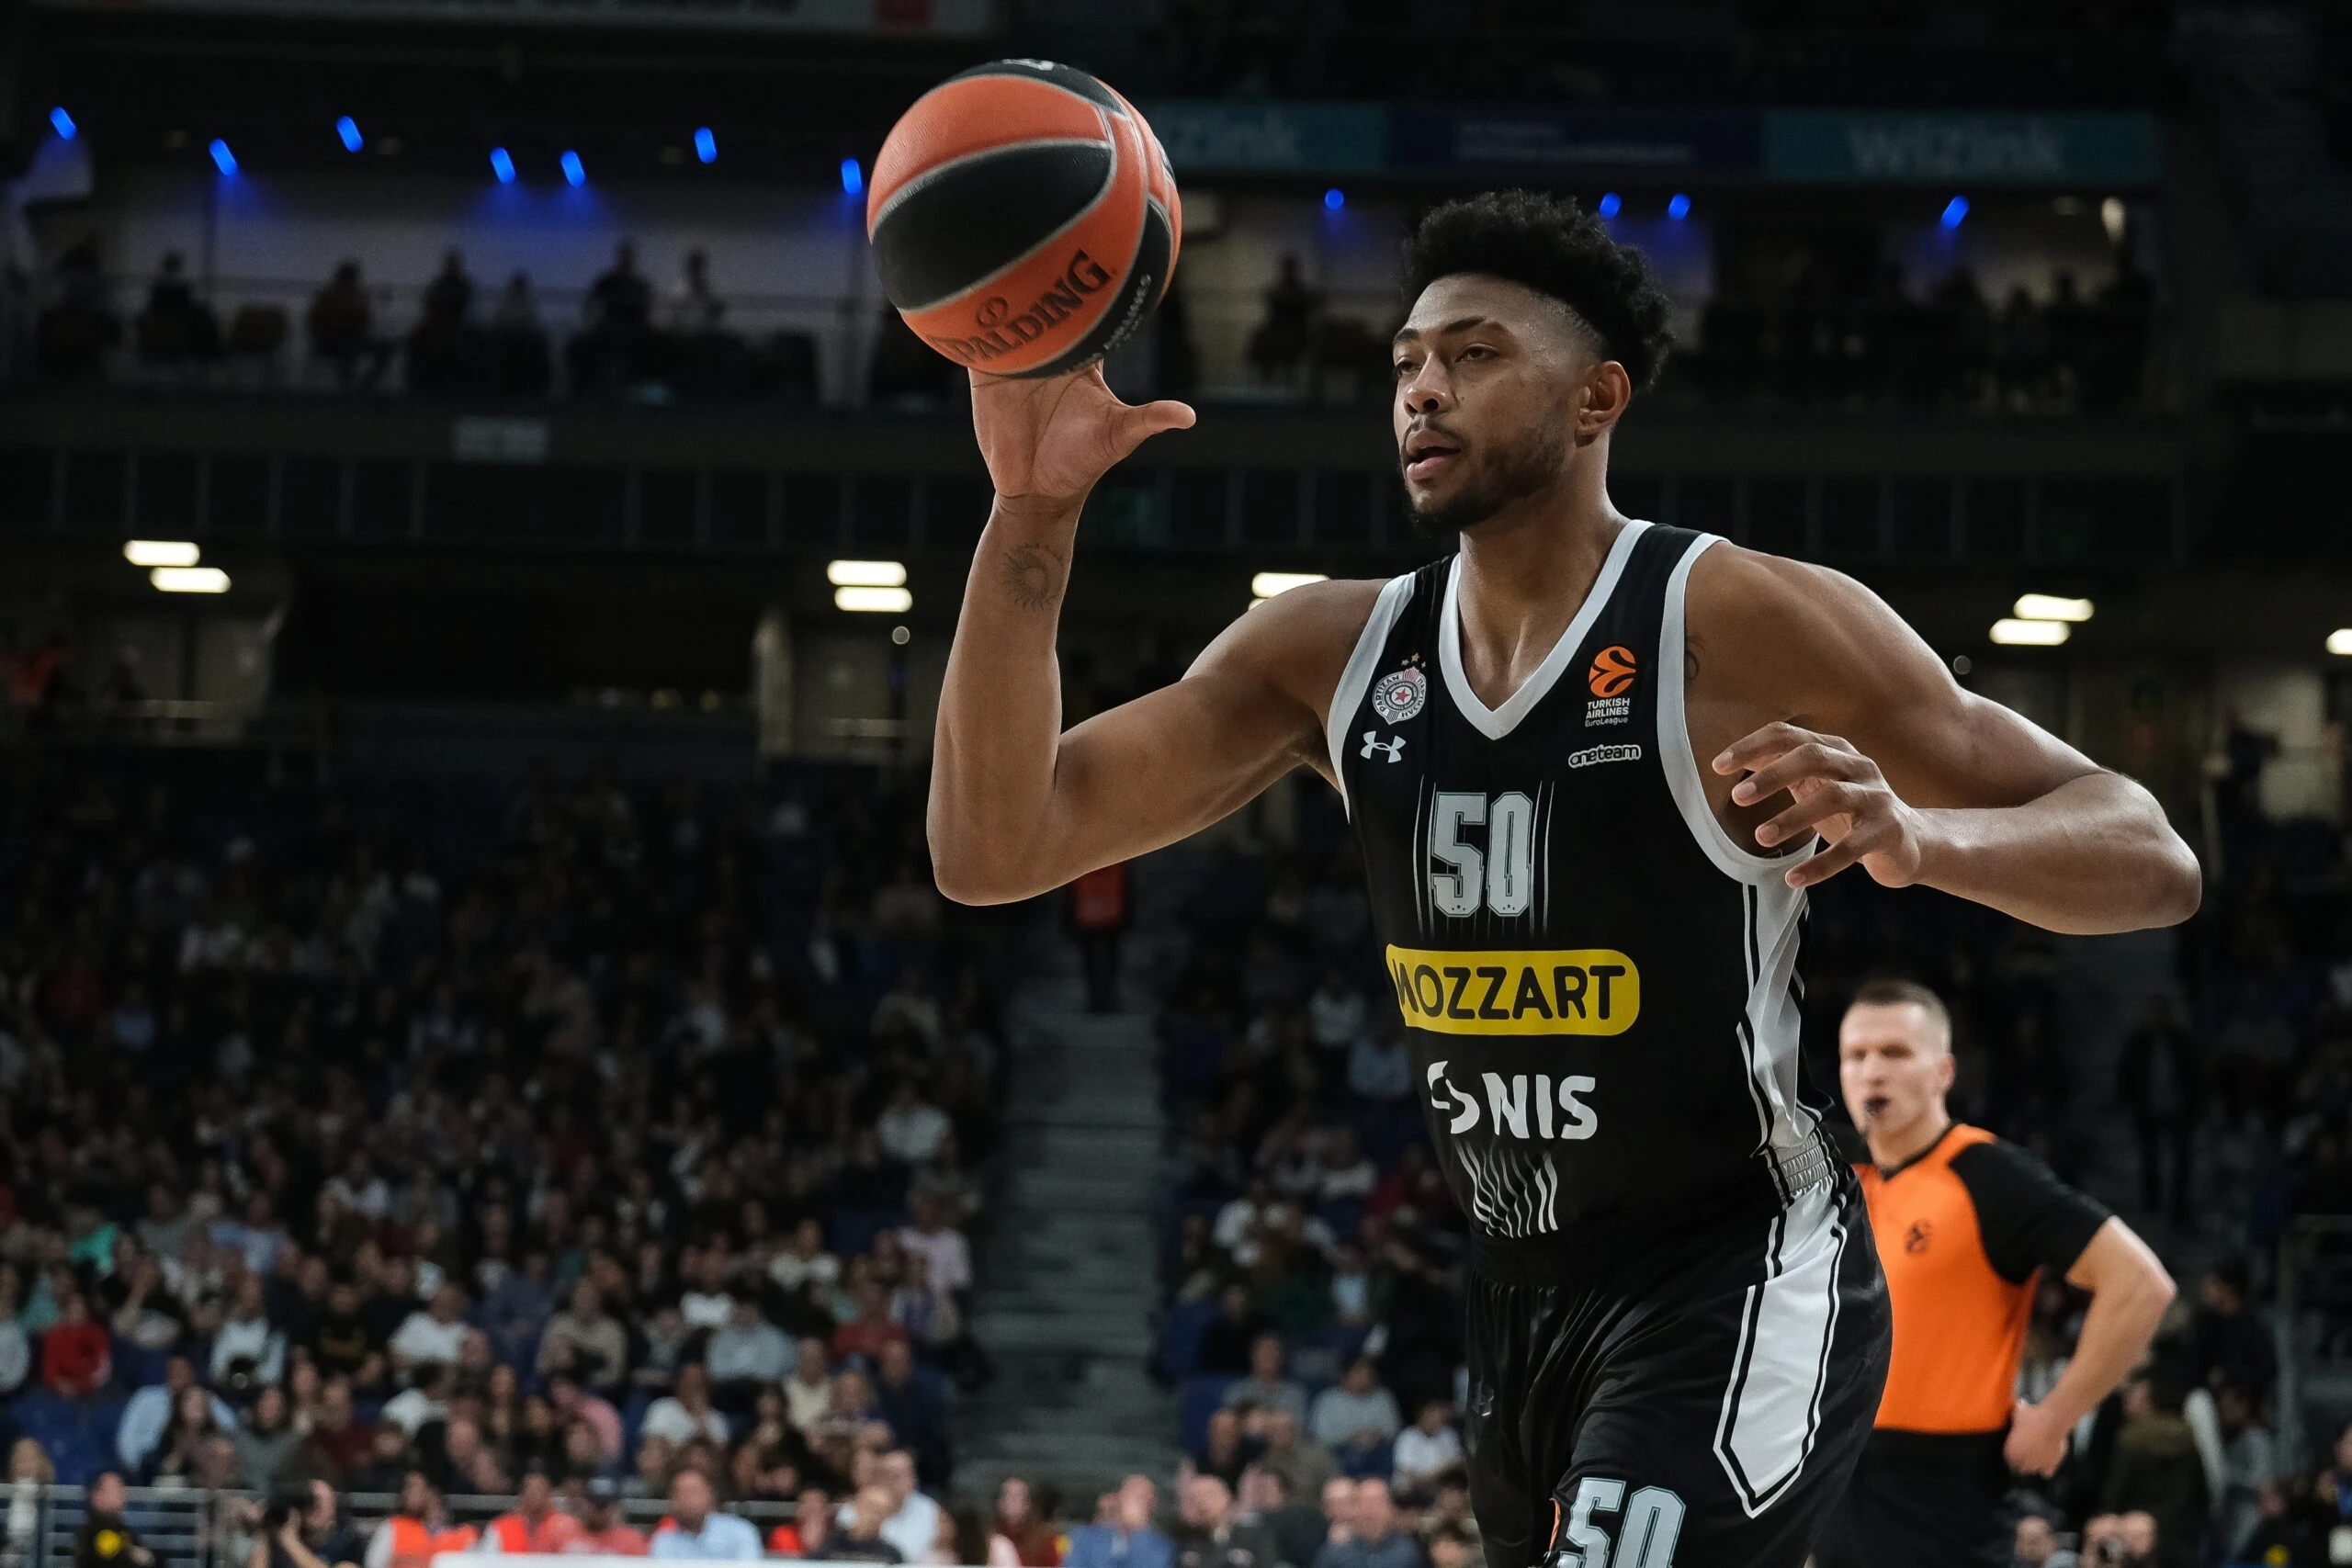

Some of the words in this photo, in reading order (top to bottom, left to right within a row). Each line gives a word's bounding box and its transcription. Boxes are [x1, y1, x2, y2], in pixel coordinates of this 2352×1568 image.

[1374, 675, 1401, 713] PARTIZAN
[1586, 706, 1629, 719] AIRLINES
[1587, 697, 1630, 710] TURKISH
[1585, 716, 1628, 727] EuroLeague
[1568, 745, 1641, 768] oneteam
[1430, 791, 1533, 919] 50
[1392, 959, 1625, 1020] MOZZART
[1482, 1072, 1598, 1140] NIS
[1557, 1477, 1686, 1568] 50
